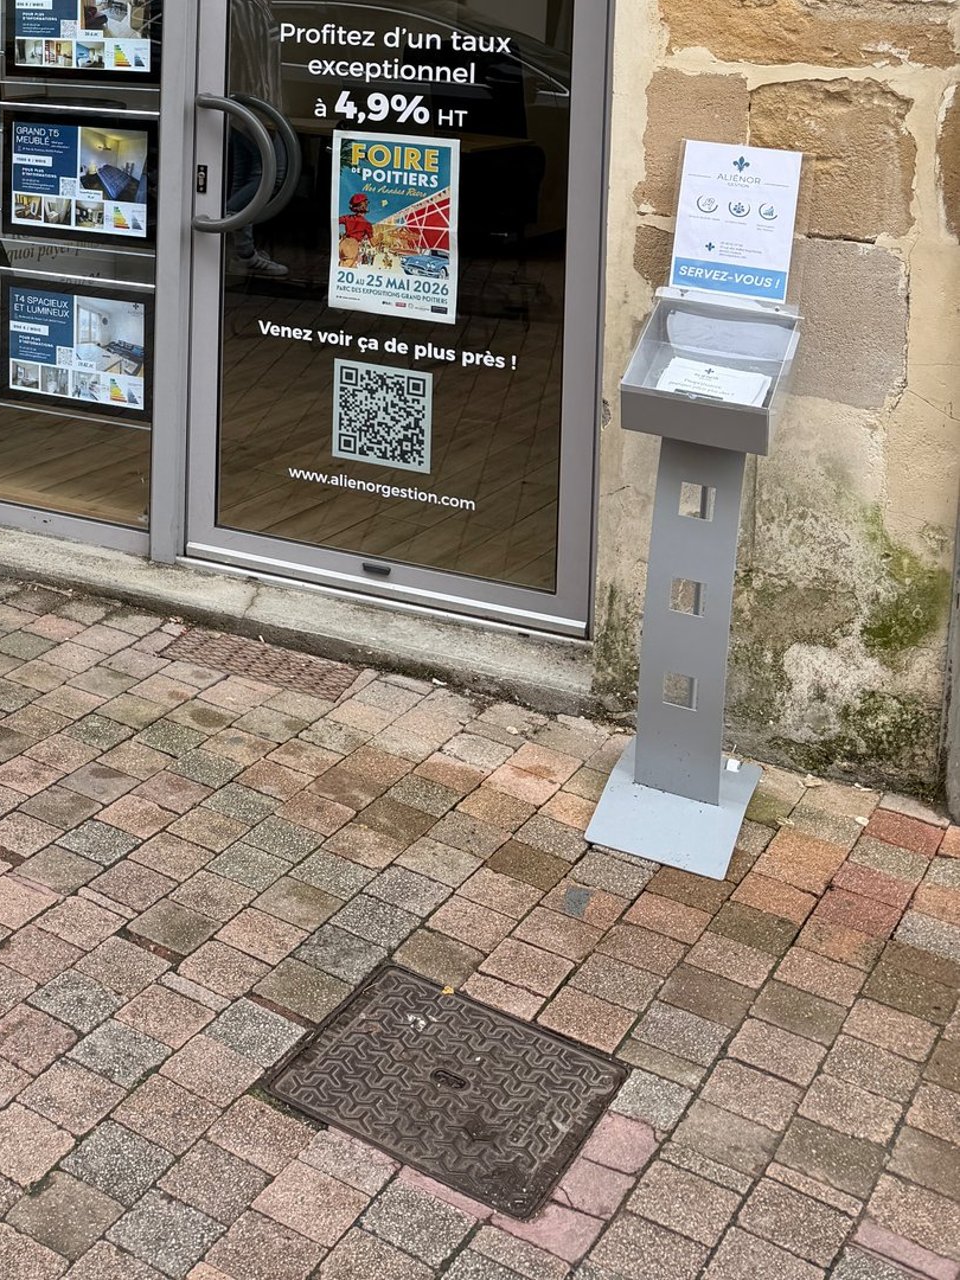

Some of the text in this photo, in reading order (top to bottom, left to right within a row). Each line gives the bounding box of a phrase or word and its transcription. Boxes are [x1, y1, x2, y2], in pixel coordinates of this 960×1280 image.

[279, 22, 512, 54] Profitez d’un taux
[307, 58, 476, 84] exceptionnel
[314, 90, 468, 127] à 4,9% HT
[15, 126, 46, 136] GRAND
[15, 134, 51, 146] MEUBLÉ
[351, 141, 440, 173] FOIRE
[362, 168, 439, 189] POITIERS
[717, 173, 761, 185] ALIÉNOR
[337, 270, 355, 284] 20
[366, 274, 383, 288] 25
[385, 278, 410, 291] MAI
[413, 280, 449, 296] 2026
[678, 265, 781, 289] SERVEZ-VOUS !
[14, 293, 69, 309] T4 SPACIEUX
[336, 285, 352, 293] PARC
[362, 288, 400, 298] EXPOSITIONS
[400, 293, 421, 301] GRAND
[422, 295, 448, 305] POITIERS
[13, 303, 70, 319] ET LUMINEUX
[258, 320, 517, 370] Venez voir ça de plus près !
[288, 467, 476, 511] www.alienorgestion.com
